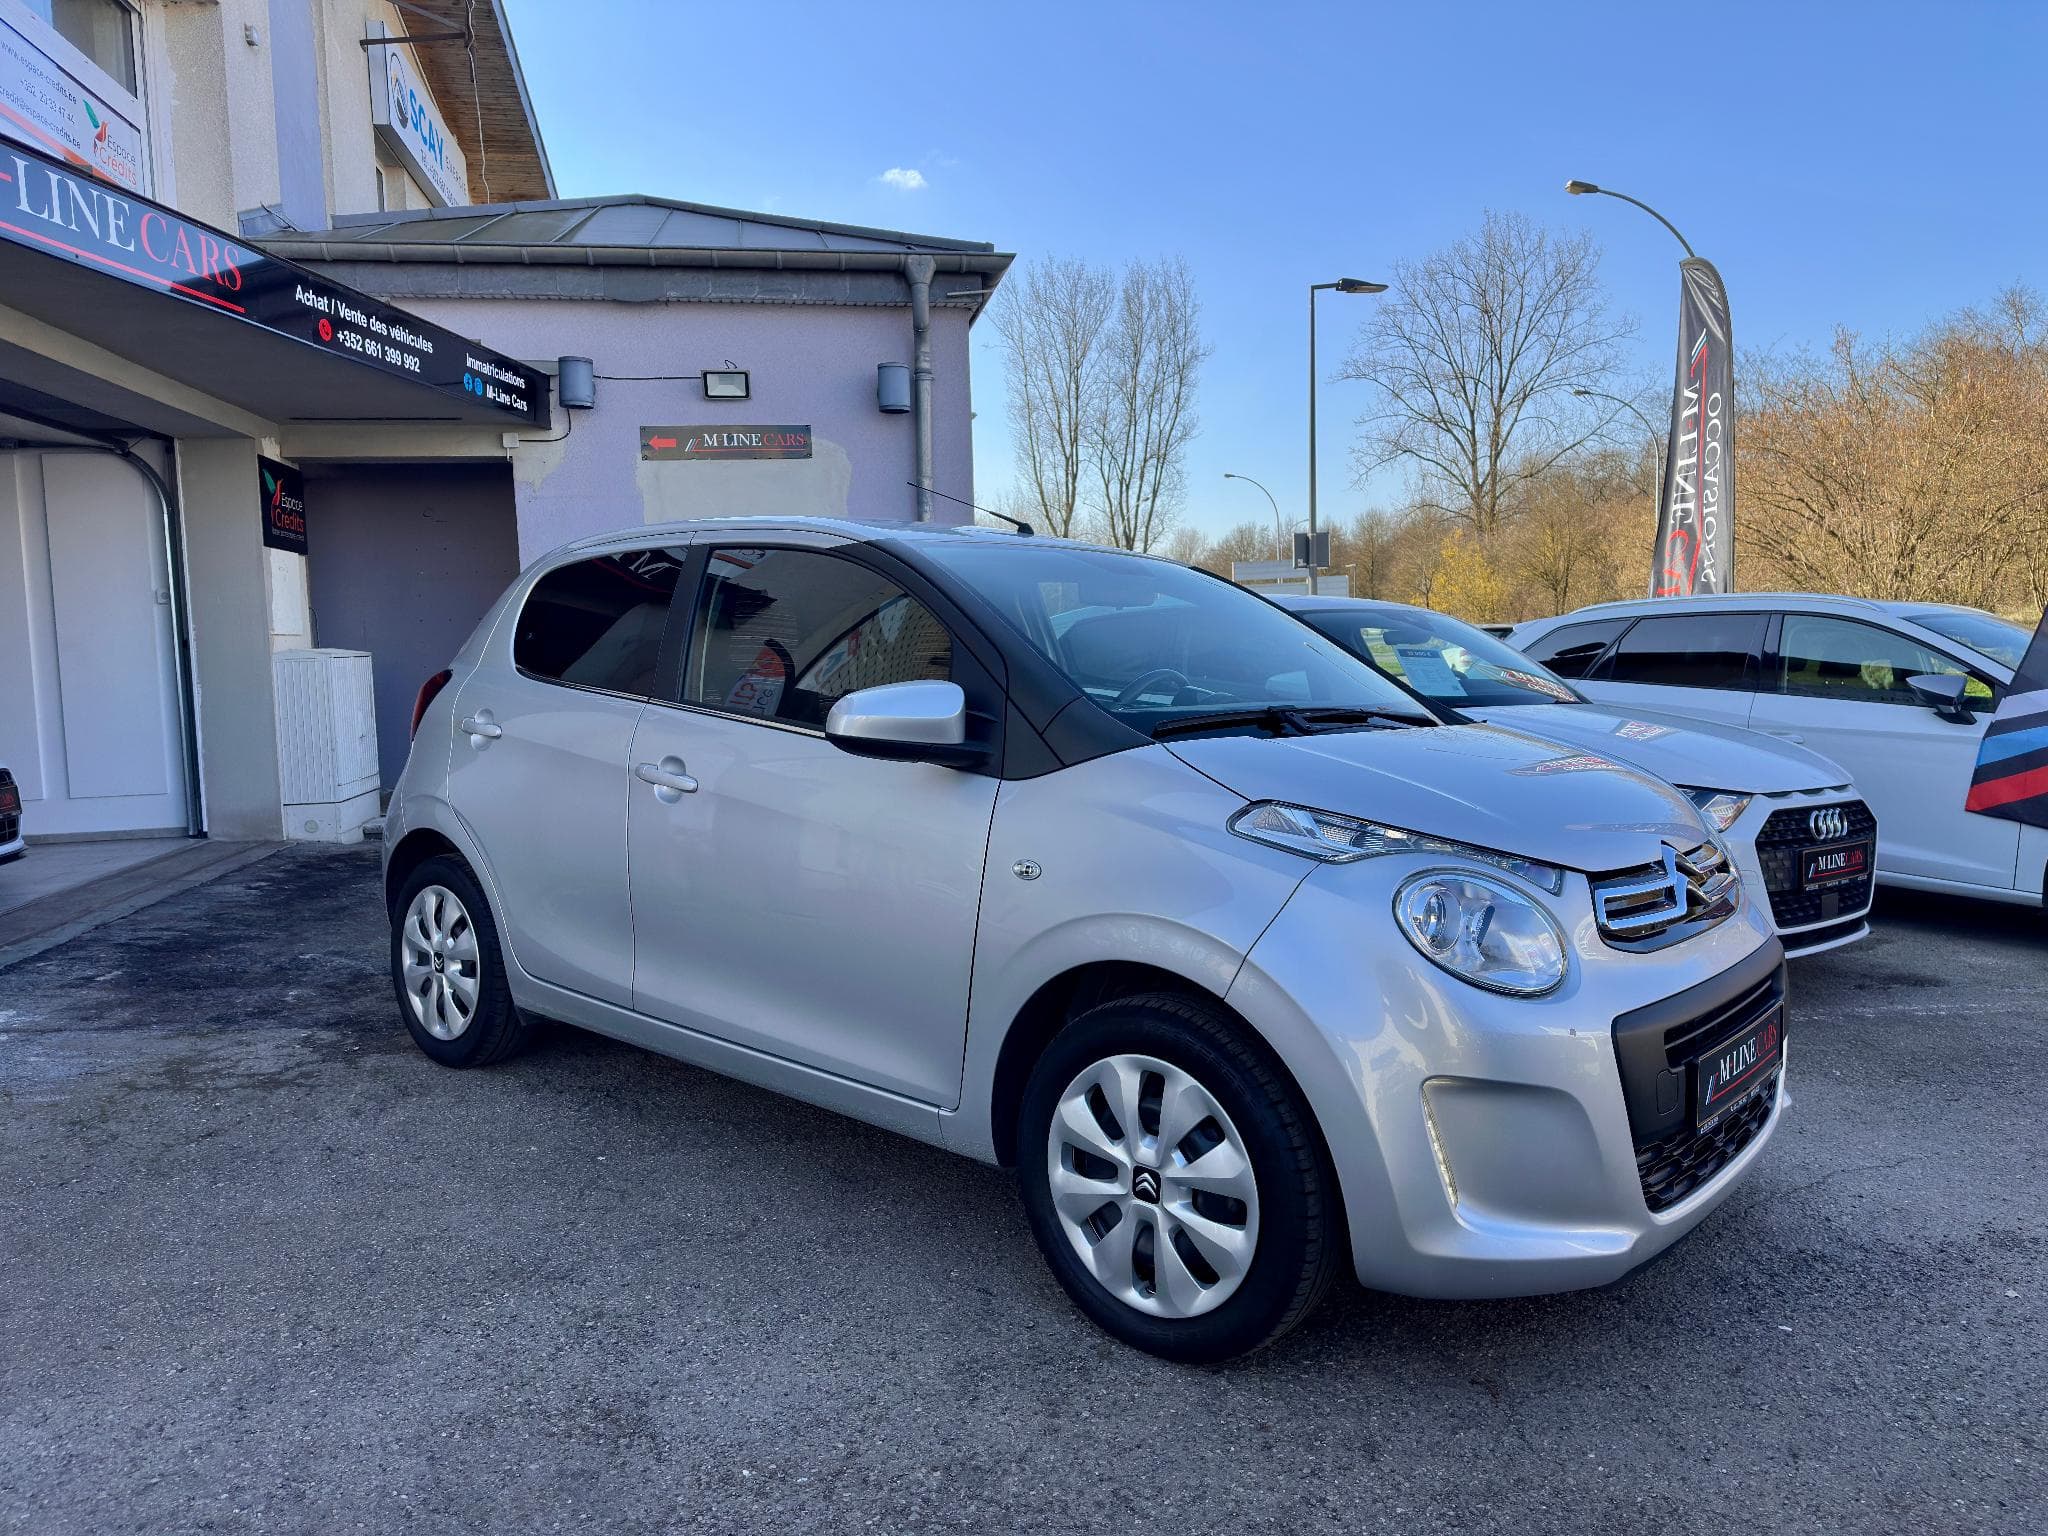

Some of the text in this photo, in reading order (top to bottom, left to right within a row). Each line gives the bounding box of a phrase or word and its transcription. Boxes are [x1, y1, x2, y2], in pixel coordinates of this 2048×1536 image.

[409, 88, 444, 171] SCAY
[107, 134, 136, 167] Espace
[140, 213, 242, 291] CARS
[295, 284, 329, 313] Achat
[337, 300, 368, 328] Vente
[369, 315, 387, 336] des
[388, 323, 434, 354] véhicules
[336, 330, 421, 374] +352 661 399 992
[466, 352, 526, 389] Immatriculations
[486, 383, 528, 412] M-Line Cars
[703, 433, 805, 447] M-LINE CARS
[1756, 1020, 1777, 1057] CARS
